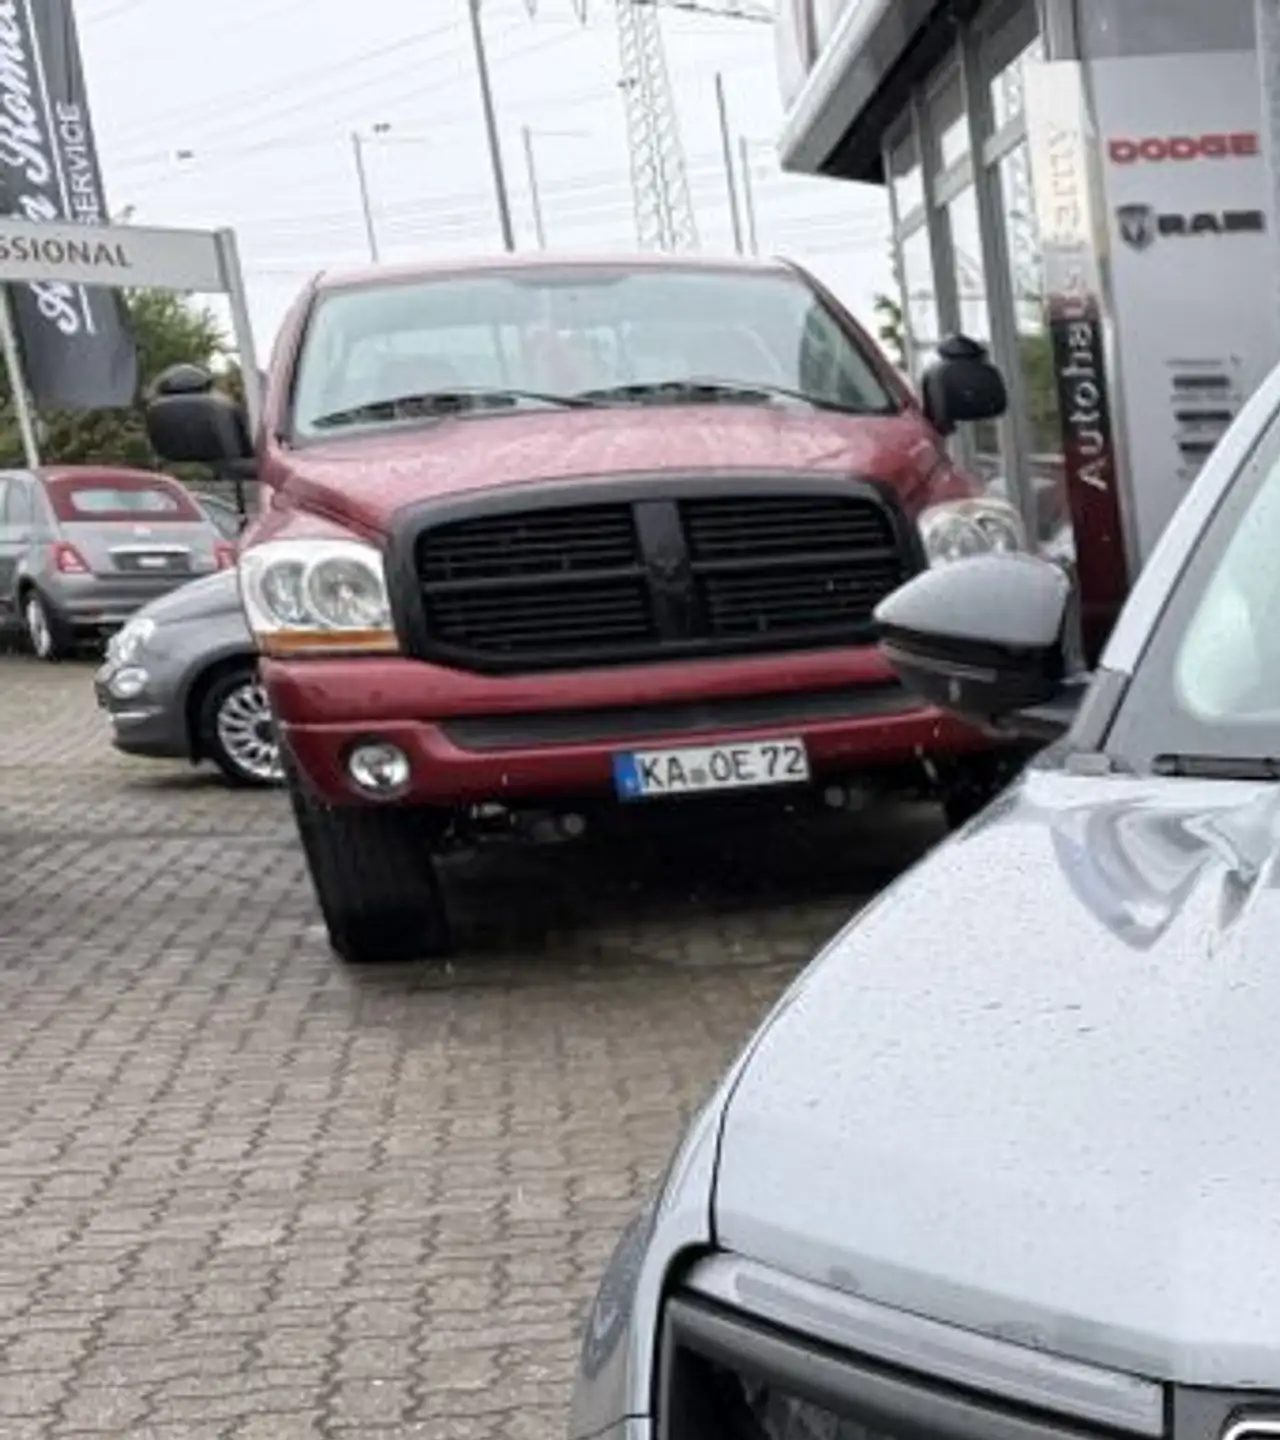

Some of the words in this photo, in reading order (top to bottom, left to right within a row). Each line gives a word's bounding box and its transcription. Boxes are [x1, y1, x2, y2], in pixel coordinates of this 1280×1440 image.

[56, 100, 99, 226] SERVICE
[1108, 132, 1260, 164] DODGE
[1157, 210, 1264, 236] RAM
[1060, 268, 1109, 491] Autohaus
[638, 756, 688, 789] KA
